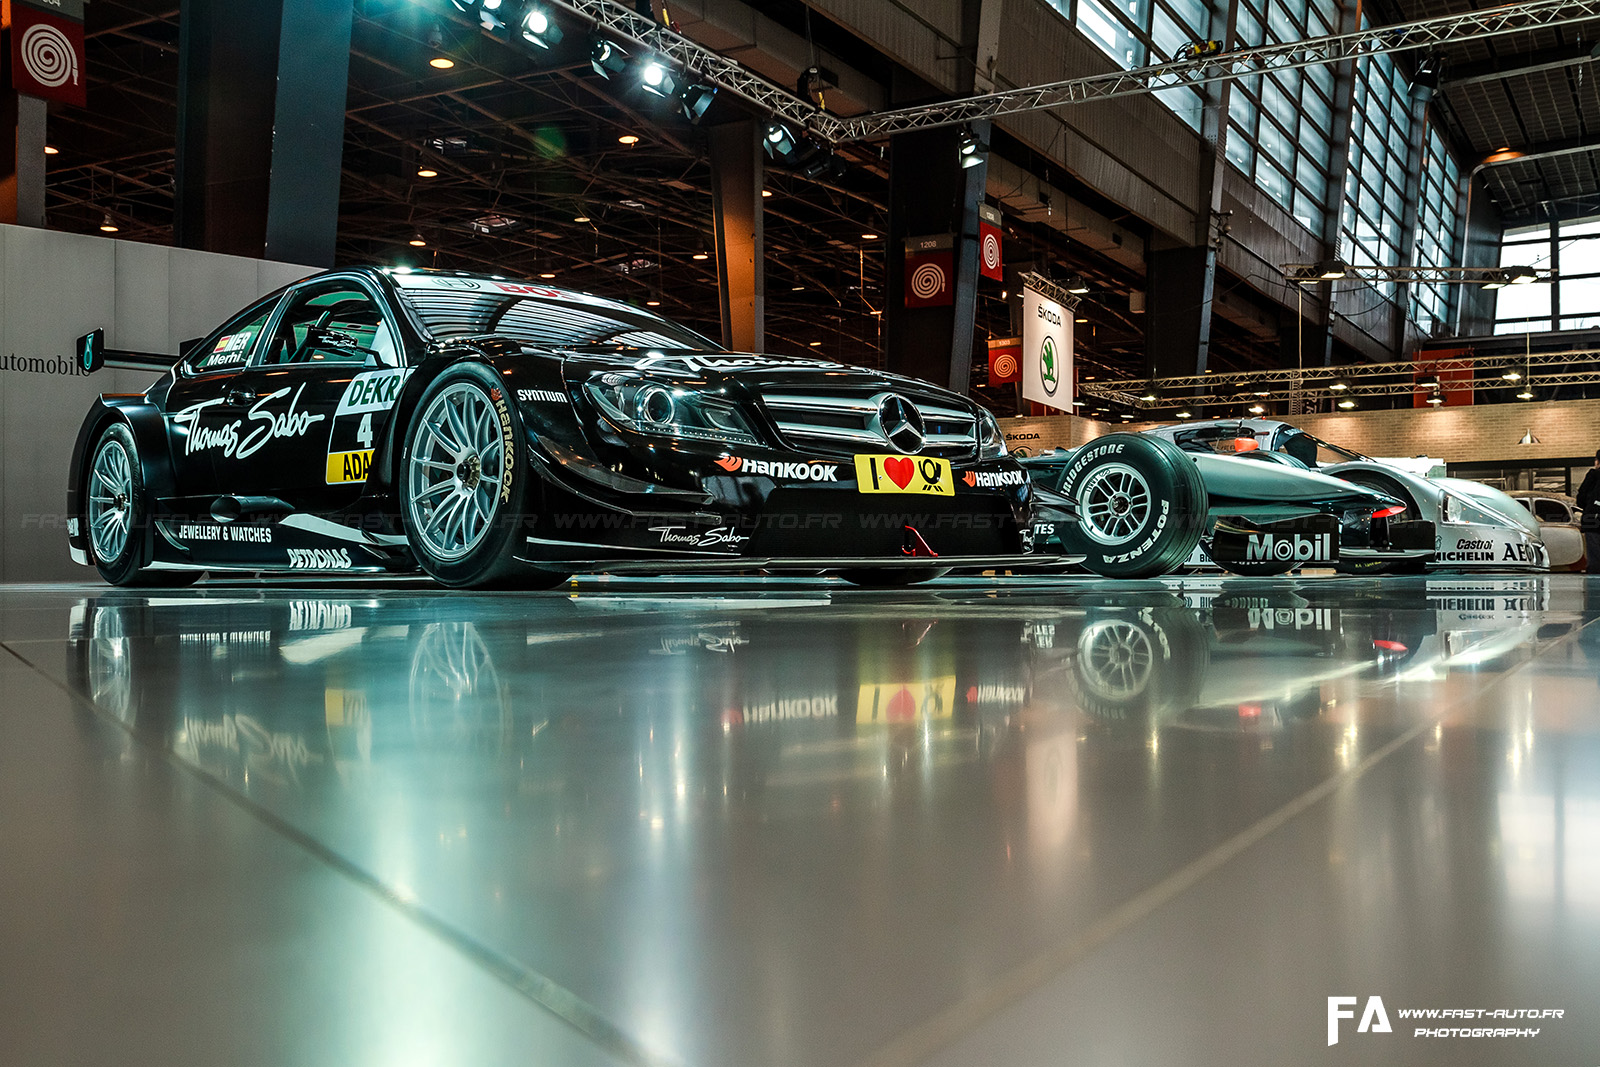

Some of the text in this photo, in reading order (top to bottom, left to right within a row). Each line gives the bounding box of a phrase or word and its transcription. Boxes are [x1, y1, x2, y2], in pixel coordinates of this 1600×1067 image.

[1037, 303, 1062, 328] ŠKODA
[206, 350, 243, 367] Merhi
[517, 389, 568, 404] SYNTIUM
[174, 382, 325, 460] Thomas Sabo
[357, 413, 374, 449] 4
[1005, 432, 1041, 441] ŠKODA
[179, 525, 272, 543] JEWELLERY & WATCHES
[648, 525, 750, 547] Thomas Sabo
[1102, 499, 1170, 564] POTENZA
[1246, 532, 1331, 562] Mobil
[286, 548, 352, 569] PETRONAS
